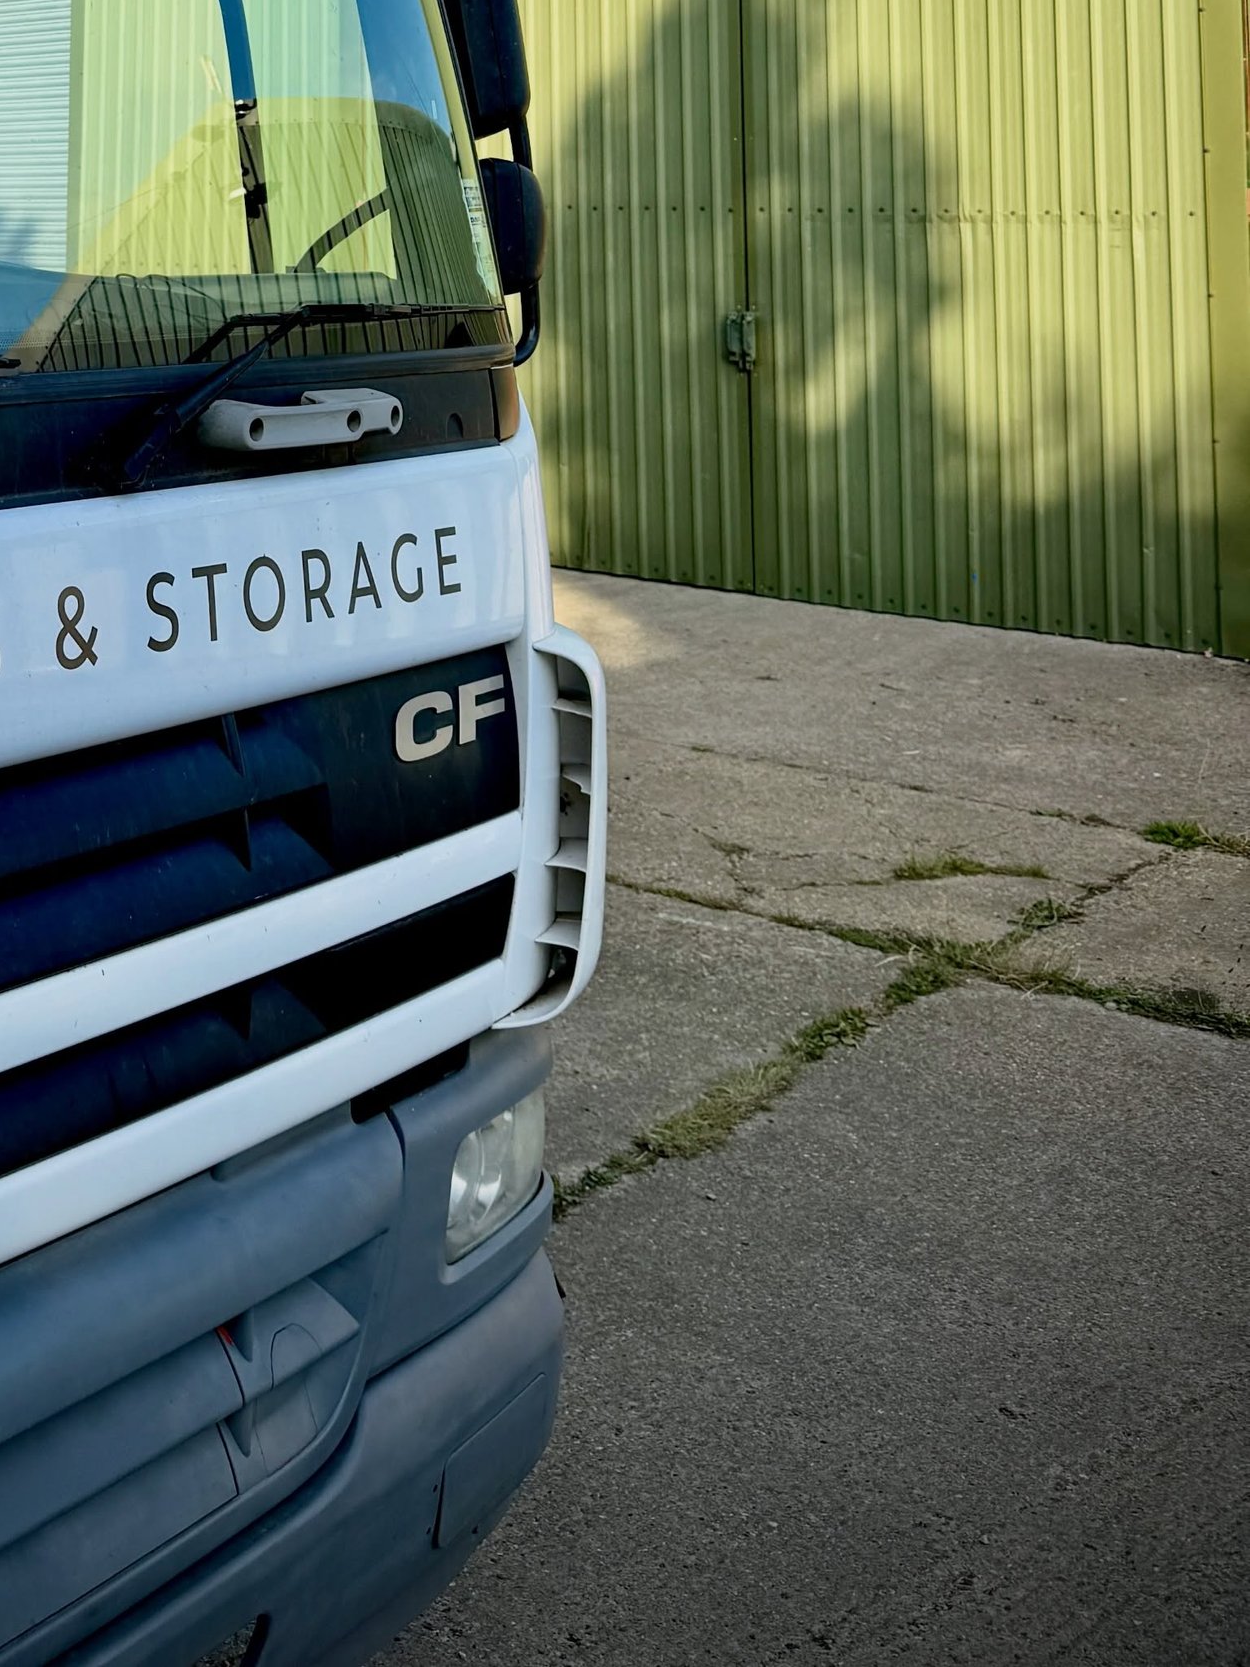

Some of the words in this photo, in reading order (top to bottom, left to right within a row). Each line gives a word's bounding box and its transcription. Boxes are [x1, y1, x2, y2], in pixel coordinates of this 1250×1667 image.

[55, 586, 98, 670] &
[145, 526, 461, 652] STORAGE
[394, 674, 505, 763] CF
